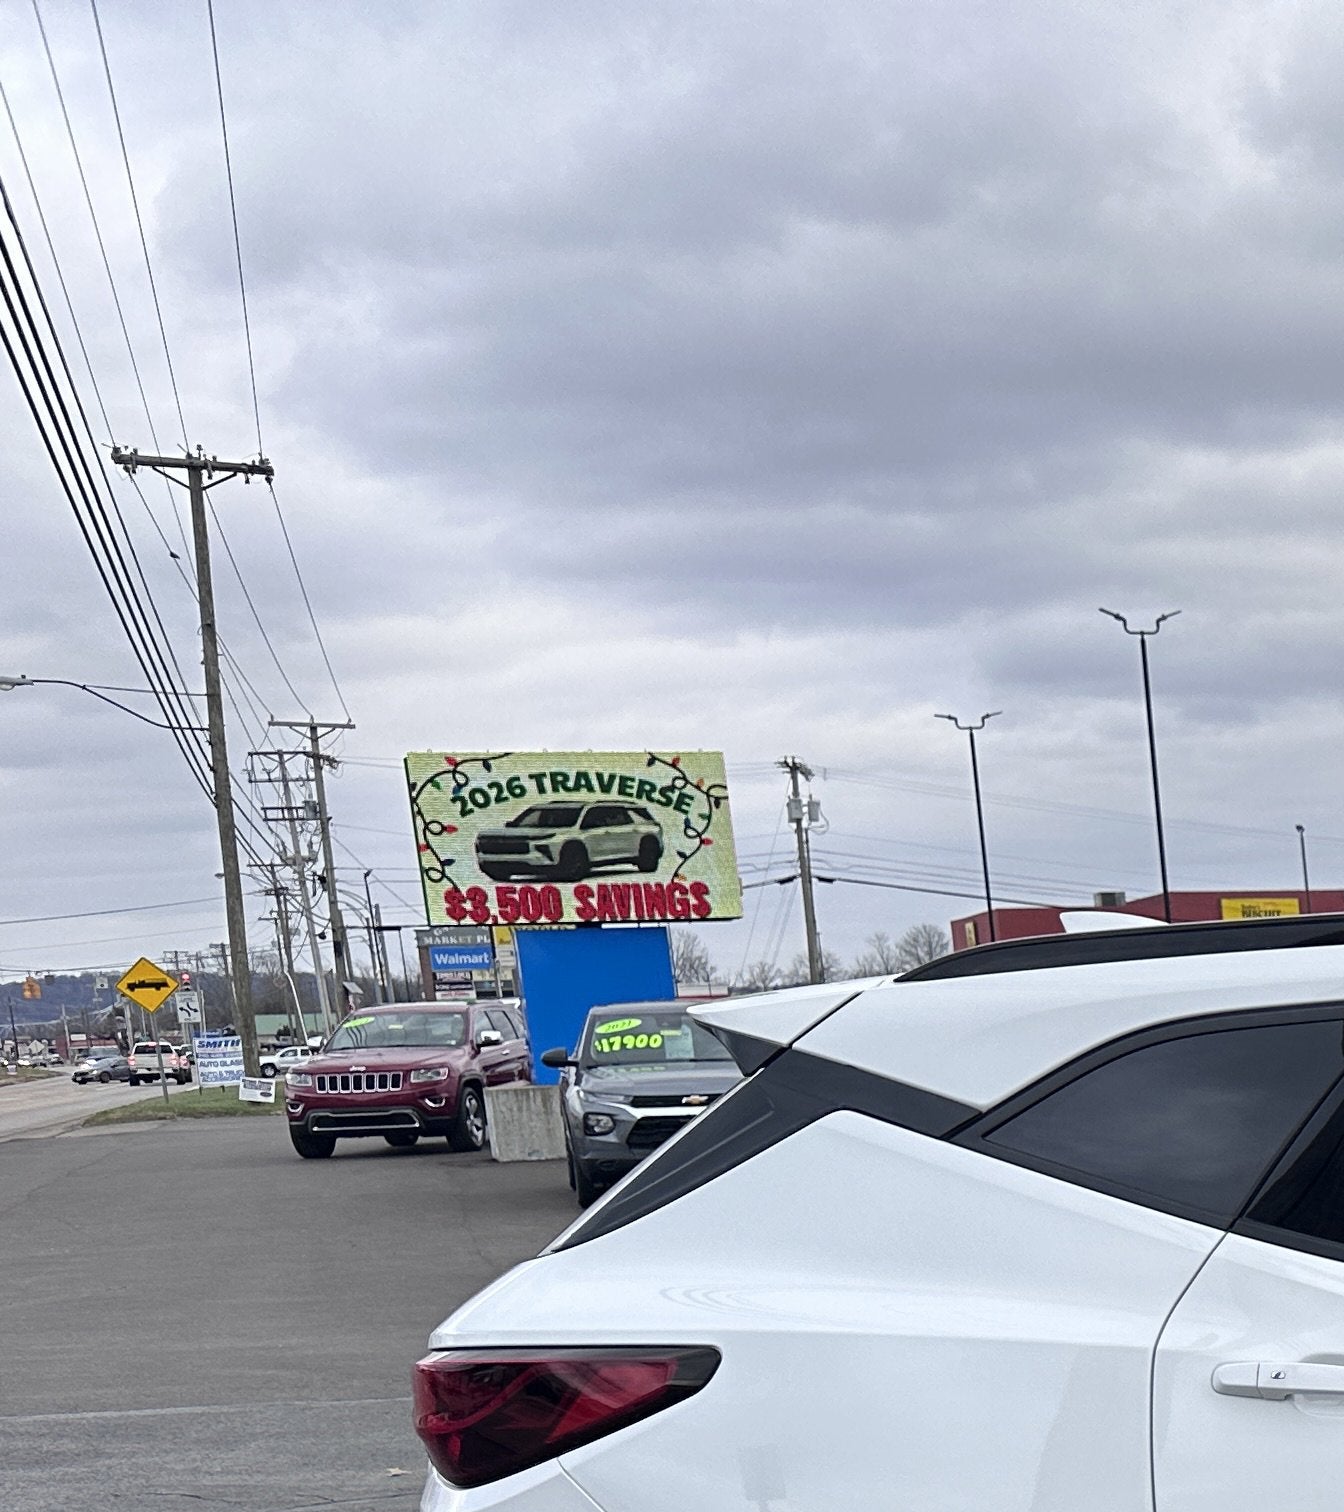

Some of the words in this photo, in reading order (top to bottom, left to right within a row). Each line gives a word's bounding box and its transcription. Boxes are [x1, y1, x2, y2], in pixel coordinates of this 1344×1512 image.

[451, 777, 527, 817] 2026
[528, 771, 694, 814] TRAVERSE
[444, 885, 564, 924] $3,500
[574, 881, 712, 921] SAVINGS
[435, 952, 489, 965] Walmart
[198, 1040, 241, 1049] SMITH
[595, 1034, 662, 1053] $17900
